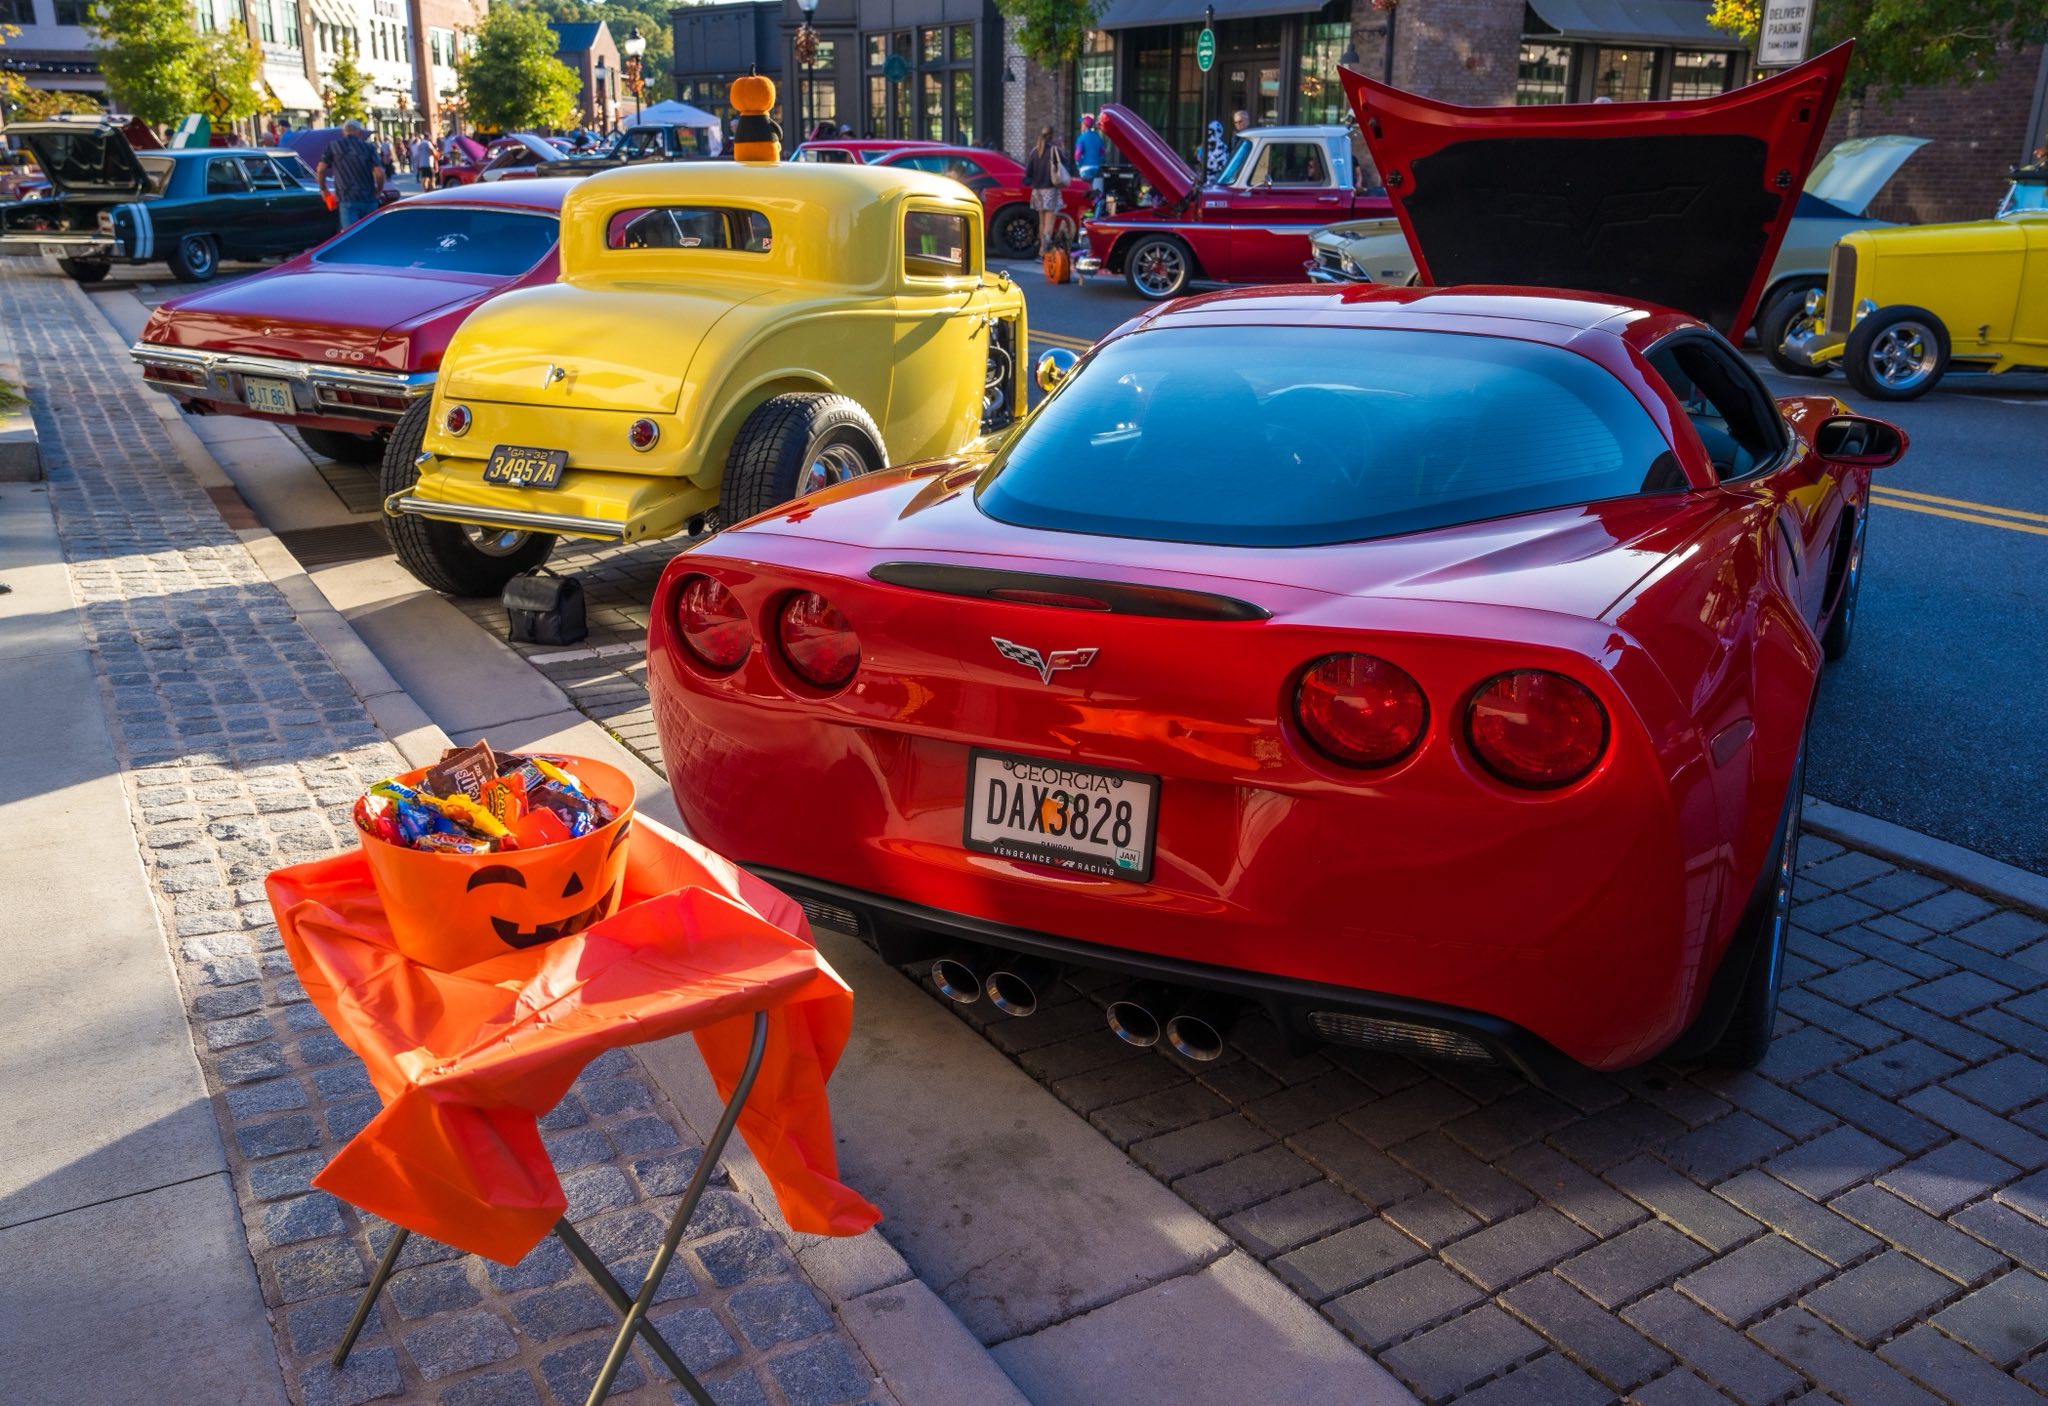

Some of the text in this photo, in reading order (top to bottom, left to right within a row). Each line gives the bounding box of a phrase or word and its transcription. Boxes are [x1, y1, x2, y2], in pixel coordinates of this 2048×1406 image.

[1769, 7, 1806, 20] DELIVERY
[1768, 23, 1802, 35] PARKING
[325, 348, 364, 360] GTO
[489, 456, 557, 482] 34957A
[1012, 762, 1111, 794] GEORGIA
[986, 778, 1132, 848] DAX3828
[993, 846, 1051, 864] VENGEANCE
[1077, 862, 1115, 876] RACING
[1120, 851, 1136, 861] JAN
